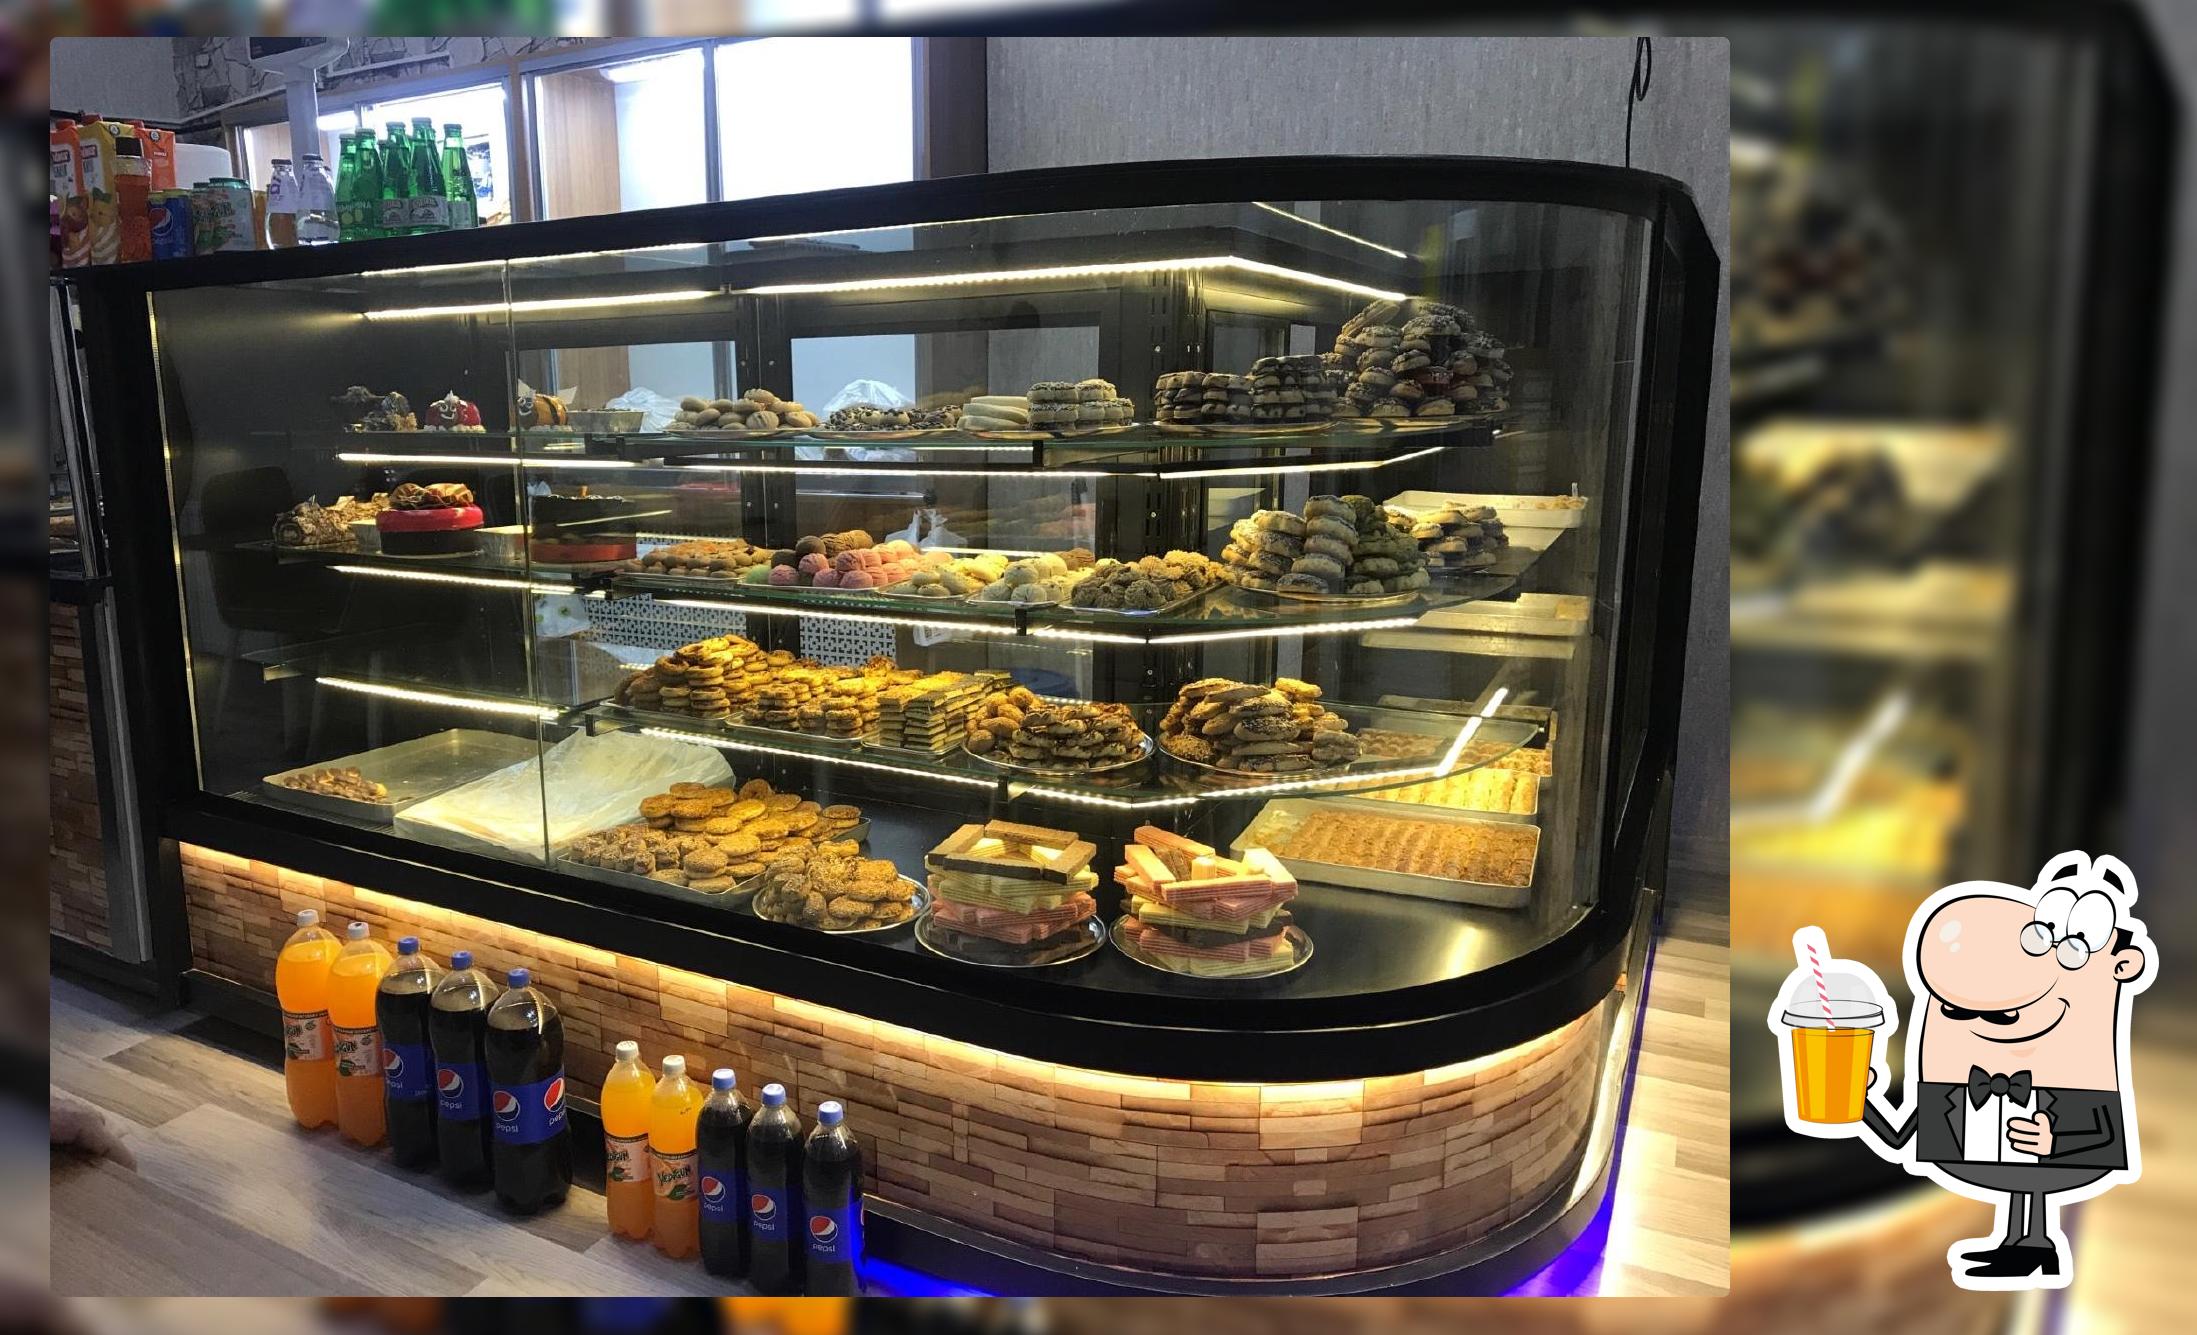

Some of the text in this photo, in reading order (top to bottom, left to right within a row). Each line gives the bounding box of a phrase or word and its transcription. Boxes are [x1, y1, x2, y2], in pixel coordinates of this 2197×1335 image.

[495, 1122, 518, 1133] pepsi
[754, 1220, 775, 1231] pepsi
[812, 1243, 836, 1253] pepsi
